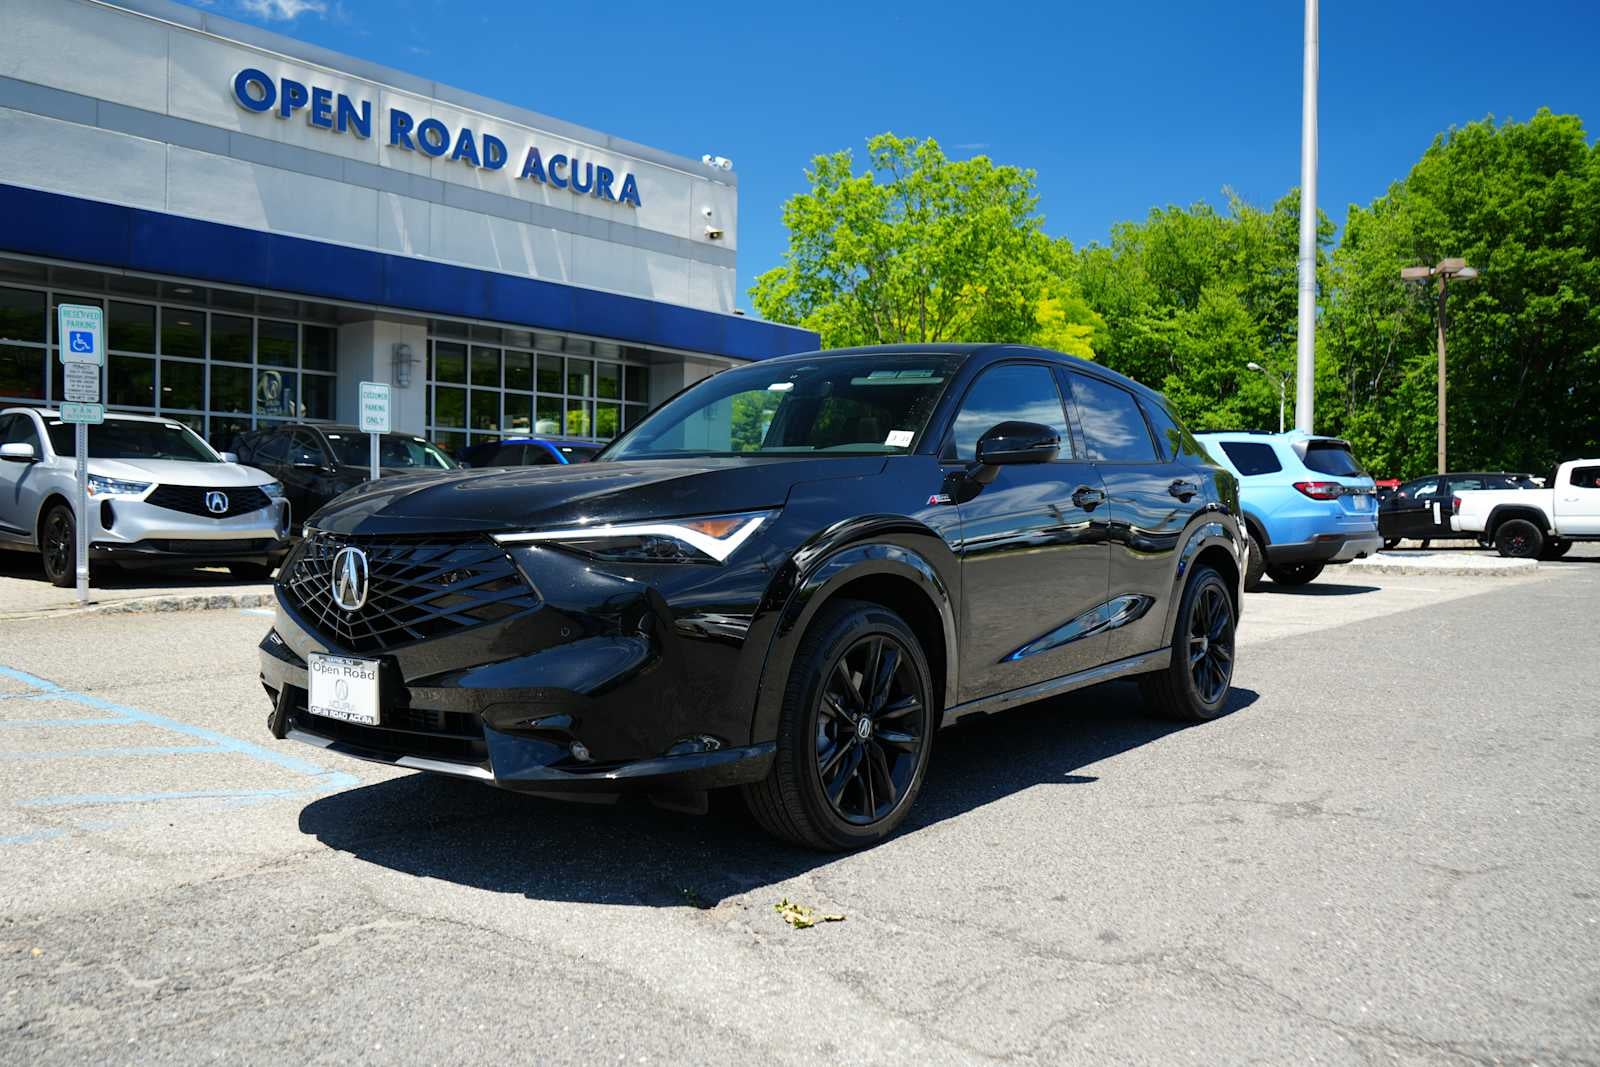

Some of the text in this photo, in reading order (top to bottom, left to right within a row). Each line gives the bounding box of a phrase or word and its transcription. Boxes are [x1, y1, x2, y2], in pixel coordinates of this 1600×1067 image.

[232, 68, 642, 207] OPEN ROAD ACURA
[63, 310, 99, 320] RESERVED
[66, 320, 97, 329] PARKING
[363, 391, 388, 400] CUSTOMER
[365, 403, 386, 412] PARKING
[366, 416, 385, 425] ONLY
[313, 661, 340, 675] Open
[343, 667, 375, 680] Road
[329, 710, 348, 720] ROAD
[348, 714, 373, 725] ACURA
